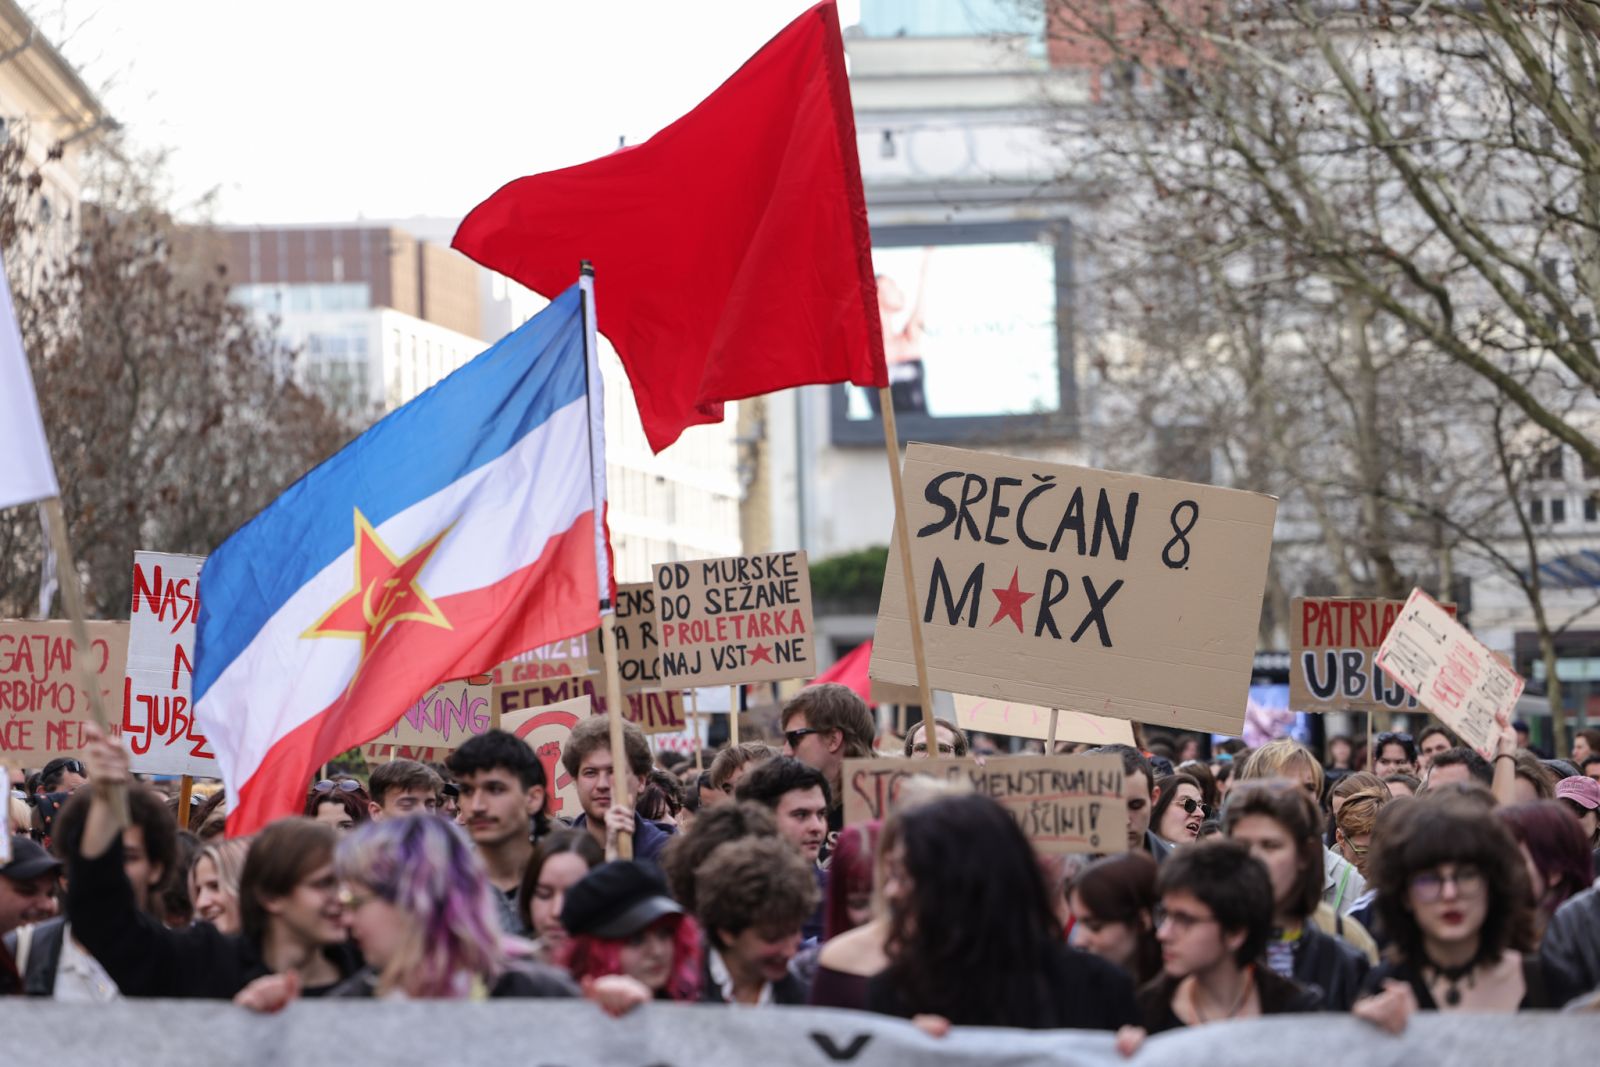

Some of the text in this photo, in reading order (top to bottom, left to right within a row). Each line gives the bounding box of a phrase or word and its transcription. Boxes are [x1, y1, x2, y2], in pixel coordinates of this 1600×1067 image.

[917, 471, 1139, 561] SREČAN
[658, 552, 799, 590] OD MURSKE
[661, 578, 800, 622] DO SEŽANE
[663, 609, 806, 647] PROLETARKA
[663, 650, 701, 677] NAJ
